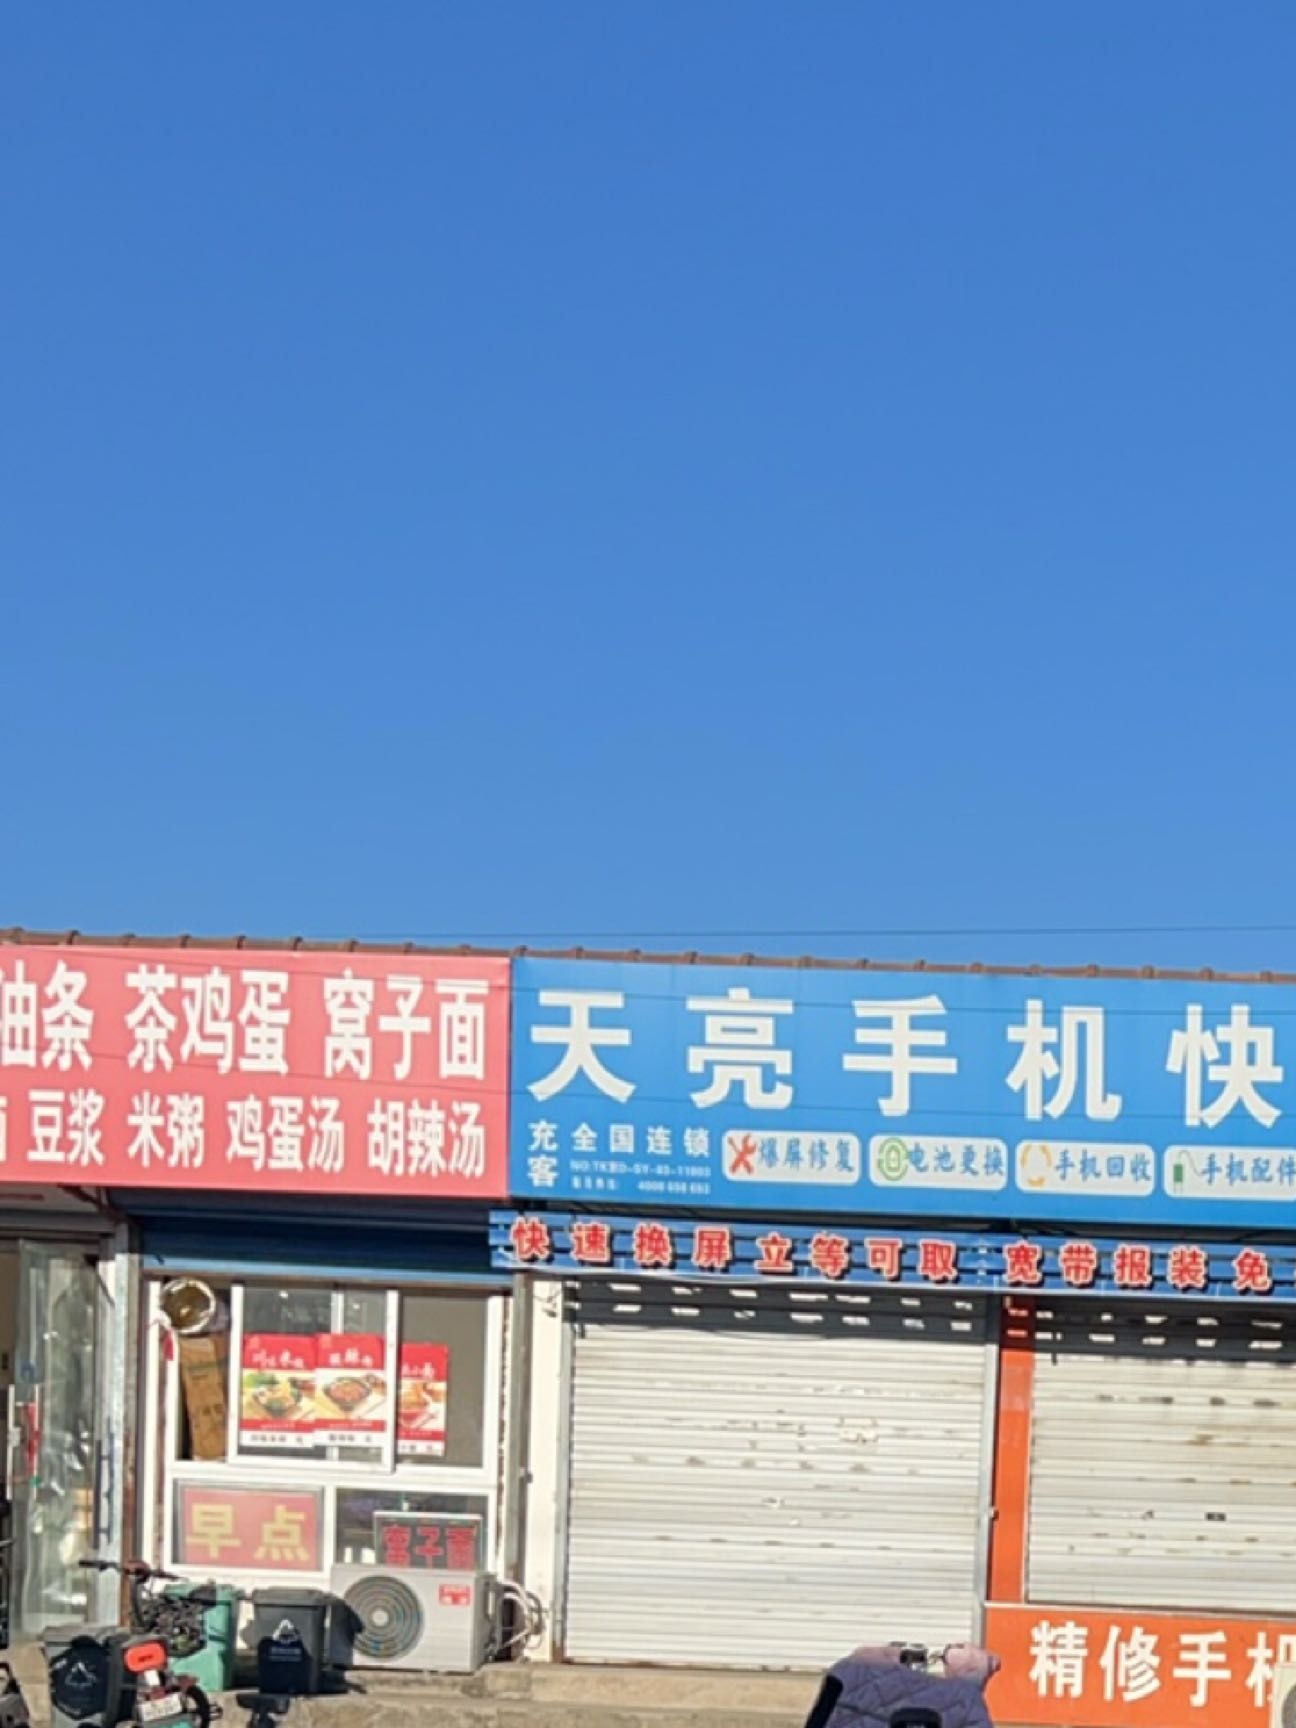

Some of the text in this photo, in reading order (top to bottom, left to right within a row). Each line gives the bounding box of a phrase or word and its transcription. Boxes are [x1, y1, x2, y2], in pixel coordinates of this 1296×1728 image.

[0, 959, 489, 1080] 油条 茶鸡蛋 窝子面
[27, 1088, 105, 1166] 豆浆
[128, 1090, 204, 1168] 米粥
[226, 1094, 345, 1173] 鸡蛋汤
[367, 1098, 486, 1178] 胡辣汤
[571, 1121, 710, 1159] 全国连锁
[758, 1134, 856, 1172] 爆屏修复
[906, 1142, 1004, 1177] 电池更换
[1054, 1148, 1152, 1182] 手机回收
[510, 1216, 957, 1283] 快速换屏立等可取
[185, 1503, 311, 1561] 早点
